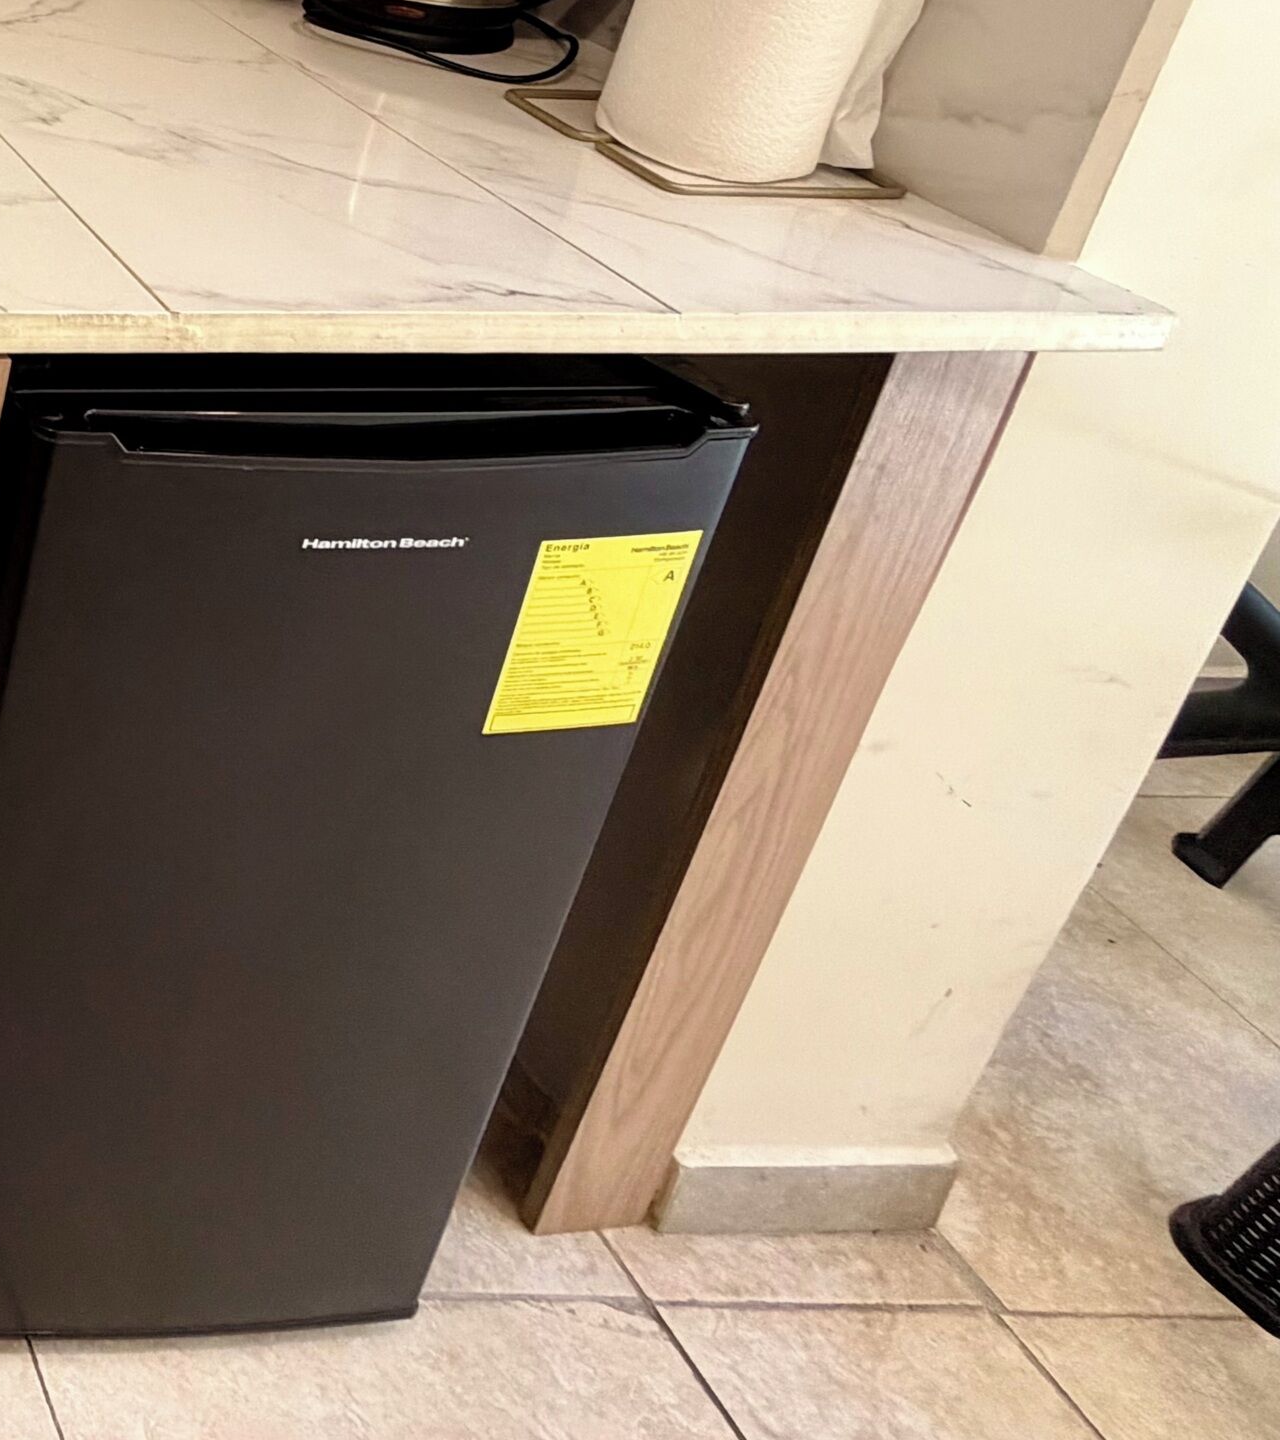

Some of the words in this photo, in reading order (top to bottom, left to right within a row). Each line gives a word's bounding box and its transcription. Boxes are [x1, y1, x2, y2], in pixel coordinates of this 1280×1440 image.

[302, 537, 397, 549] Hamilton
[399, 536, 465, 549] Beach
[663, 570, 675, 582] A
